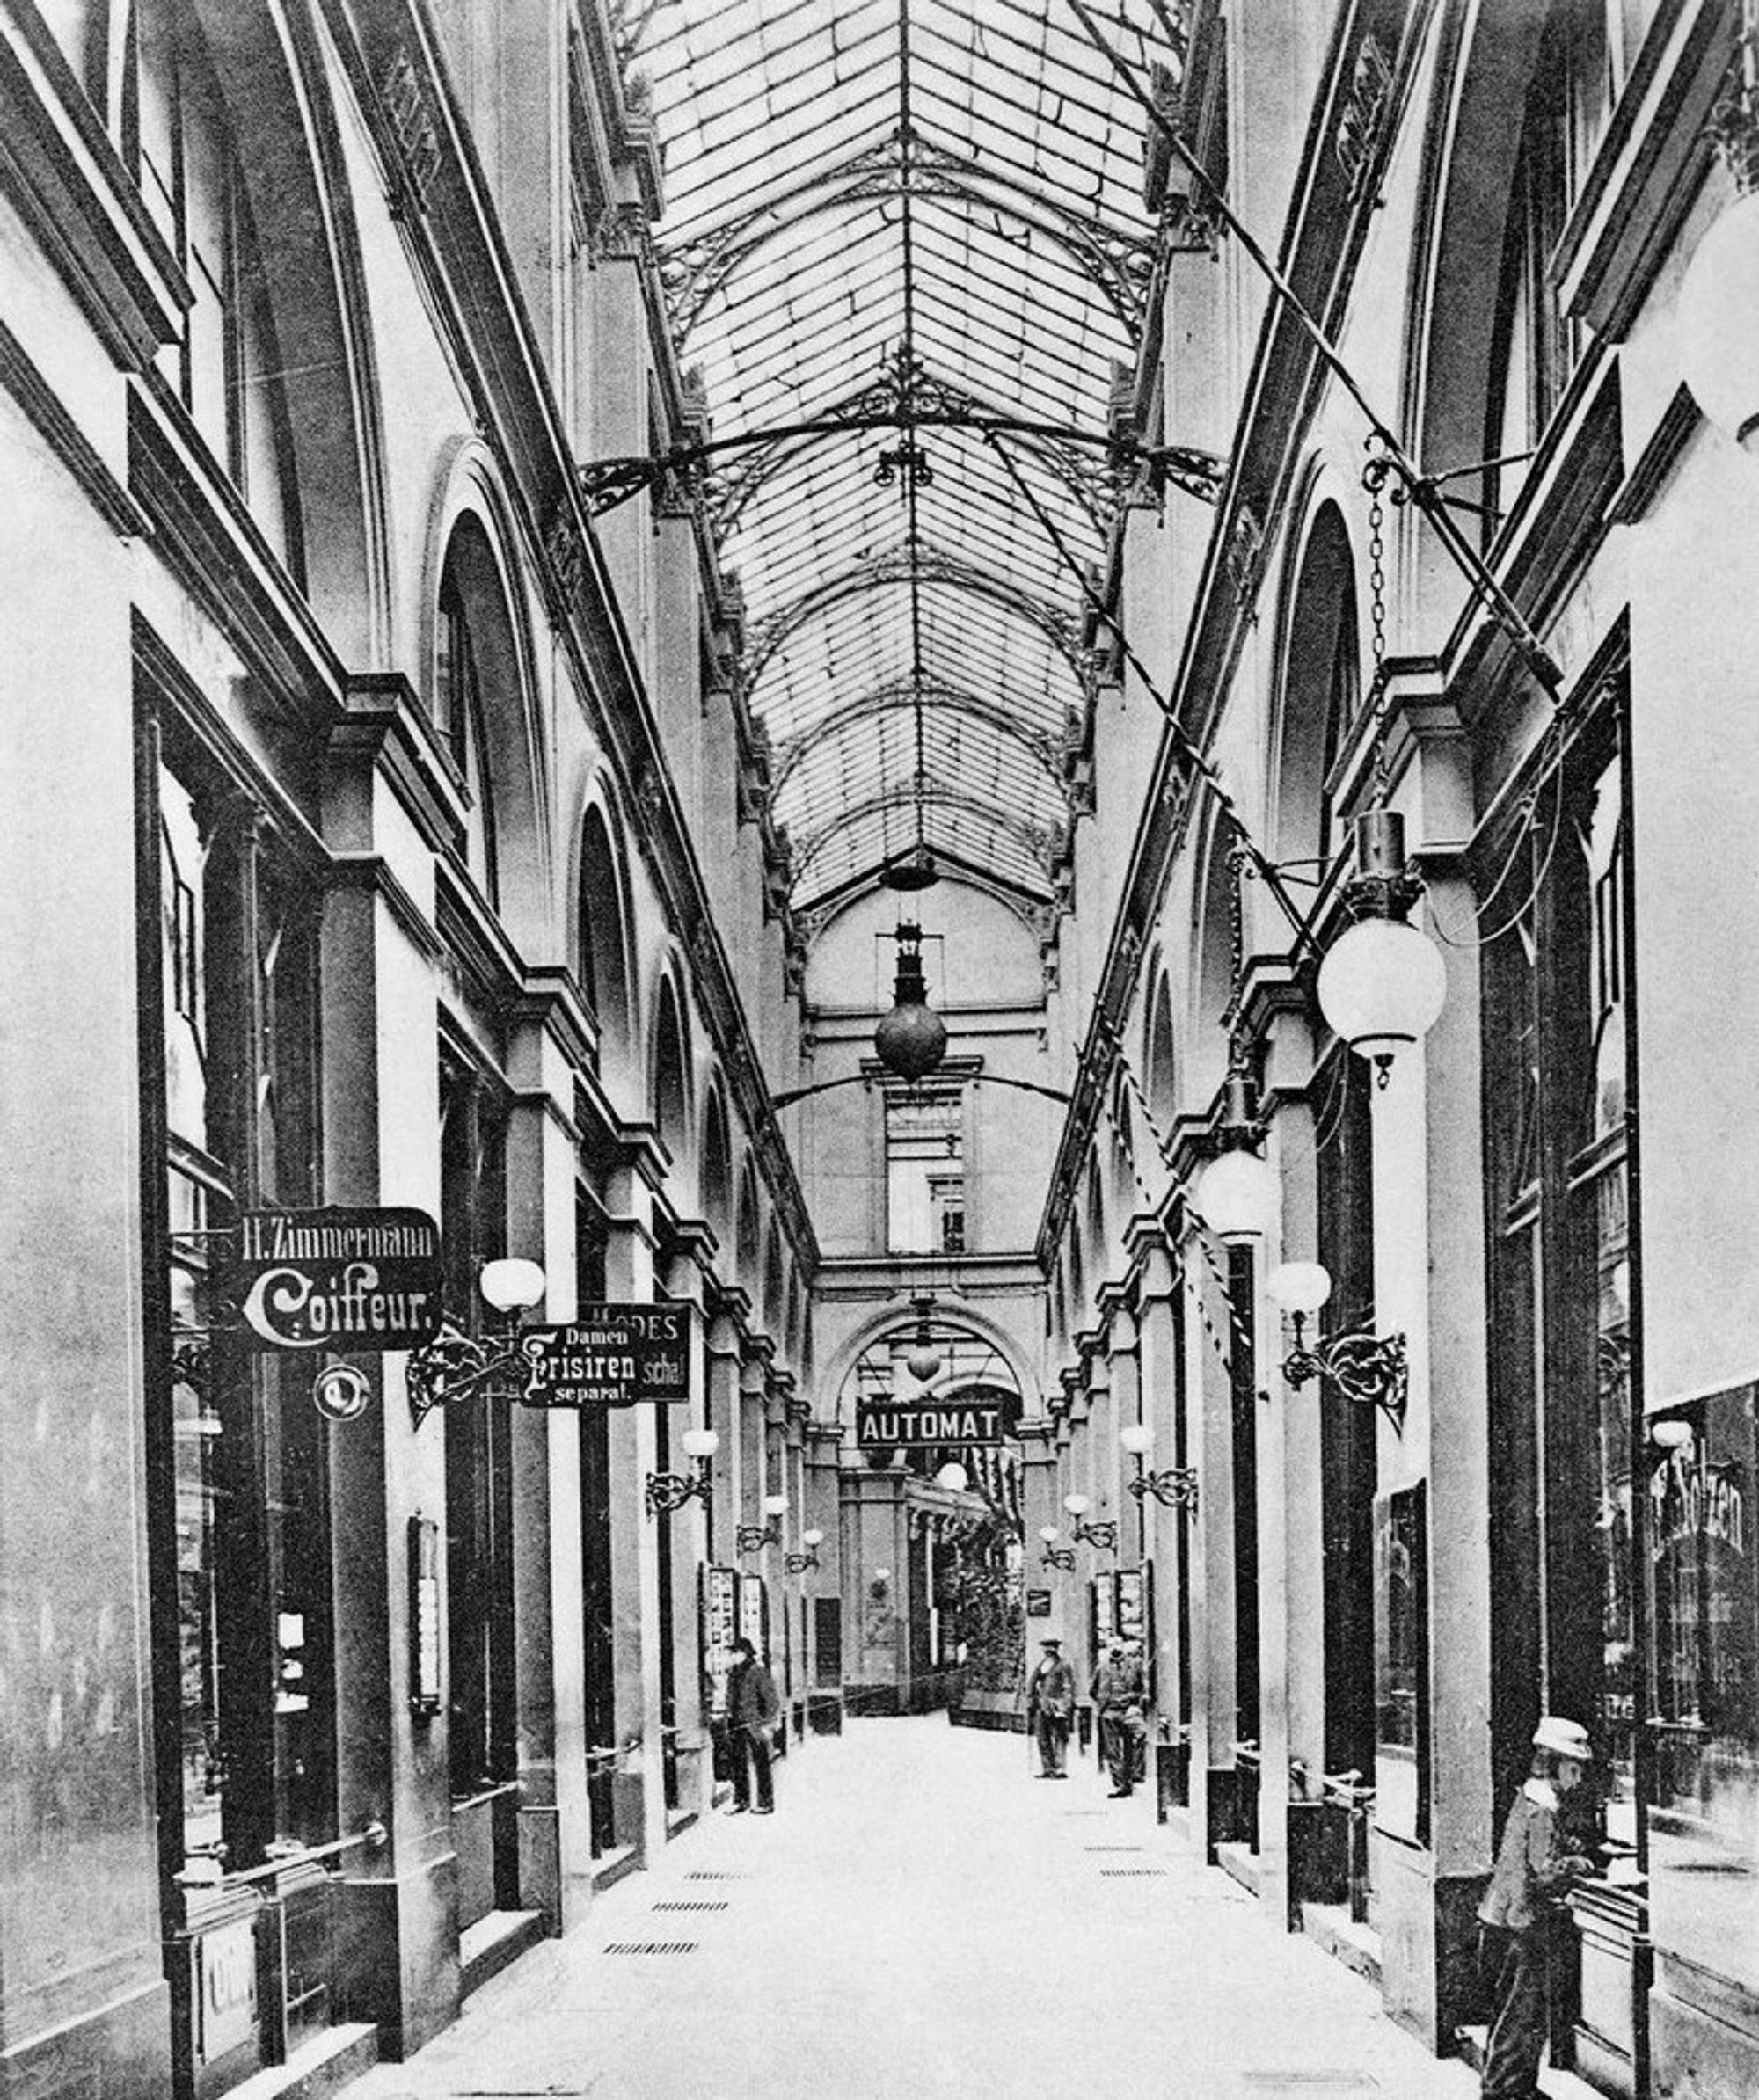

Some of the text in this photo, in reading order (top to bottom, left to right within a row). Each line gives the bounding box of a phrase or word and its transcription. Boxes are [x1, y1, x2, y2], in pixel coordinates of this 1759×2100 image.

[242, 1262, 433, 1348] Coiffeur.
[566, 1327, 628, 1345] Damen
[522, 1331, 636, 1400] Frisiren
[862, 1411, 999, 1440] AUTOMAT
